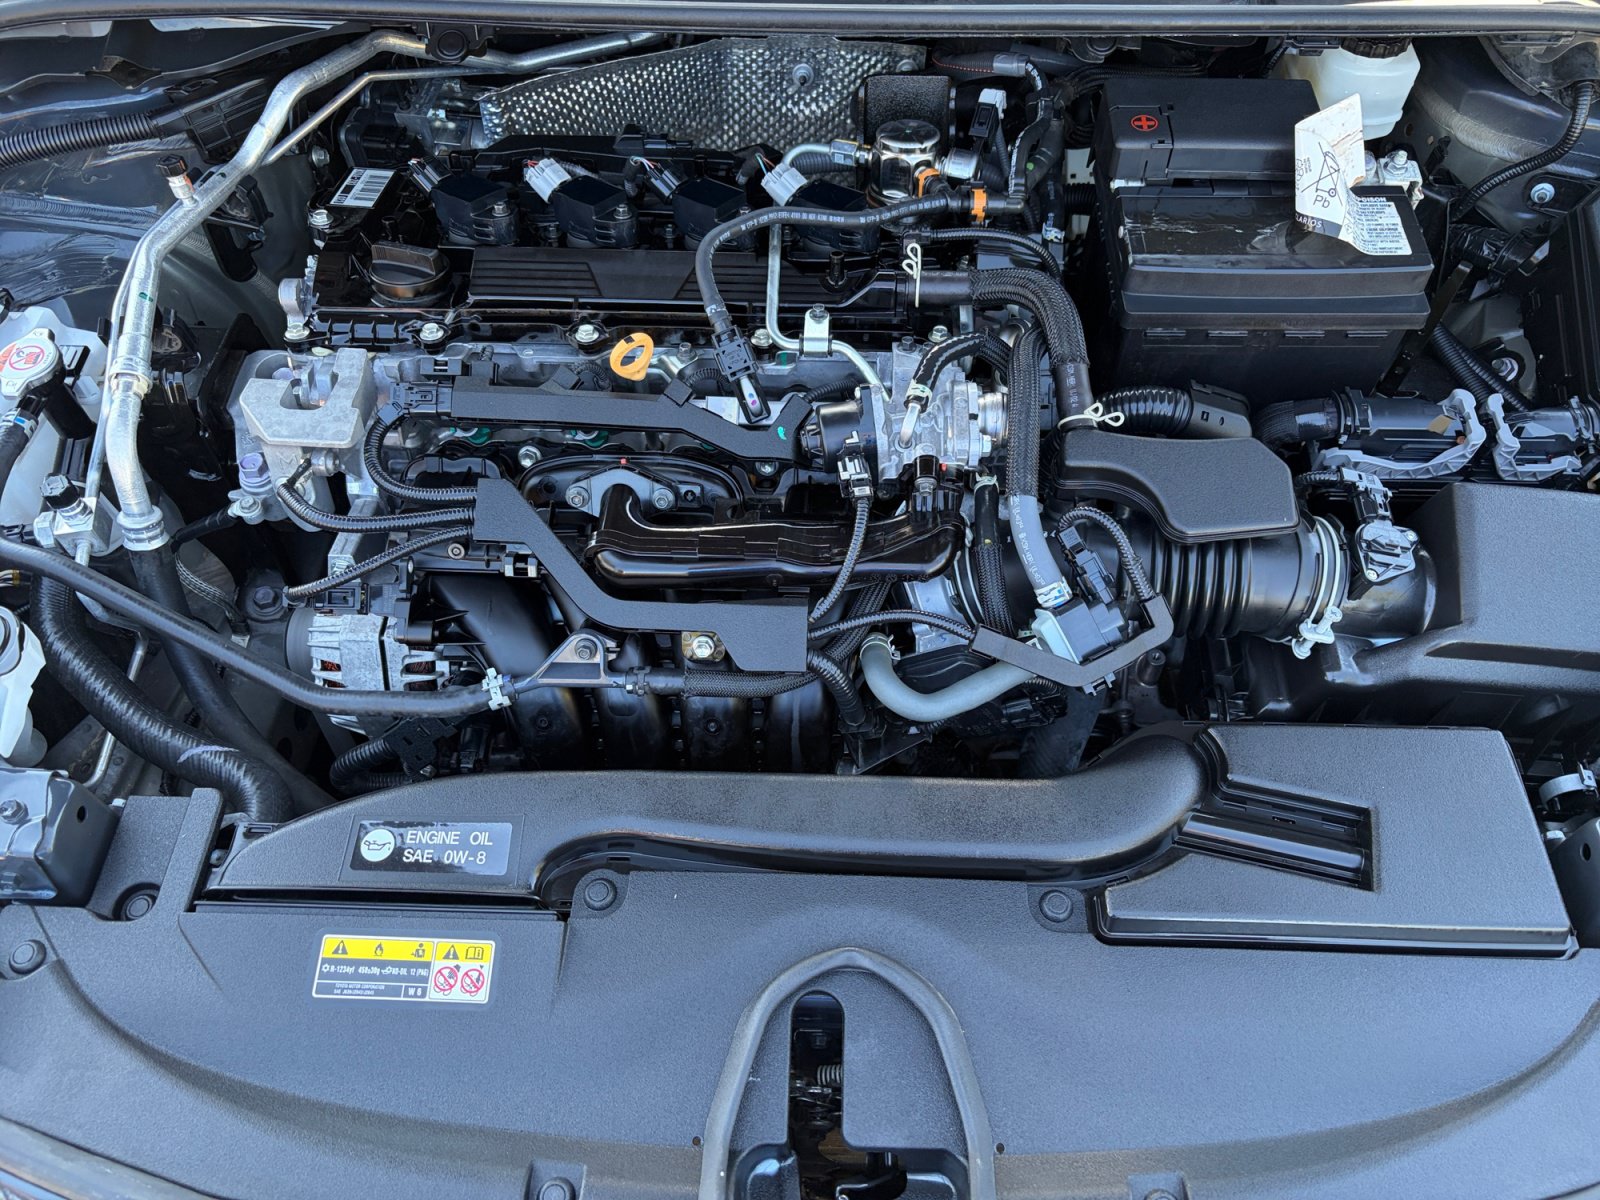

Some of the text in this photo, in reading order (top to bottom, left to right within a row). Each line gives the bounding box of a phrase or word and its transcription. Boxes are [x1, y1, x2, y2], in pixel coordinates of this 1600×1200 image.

[1313, 194, 1331, 208] Pb
[1295, 212, 1323, 228] LARIOS
[406, 830, 493, 846] ENGINE OIL
[402, 848, 486, 865] SAE 0W-8
[330, 964, 355, 974] R-1234yf
[410, 968, 416, 976] 12
[408, 987, 415, 996] W
